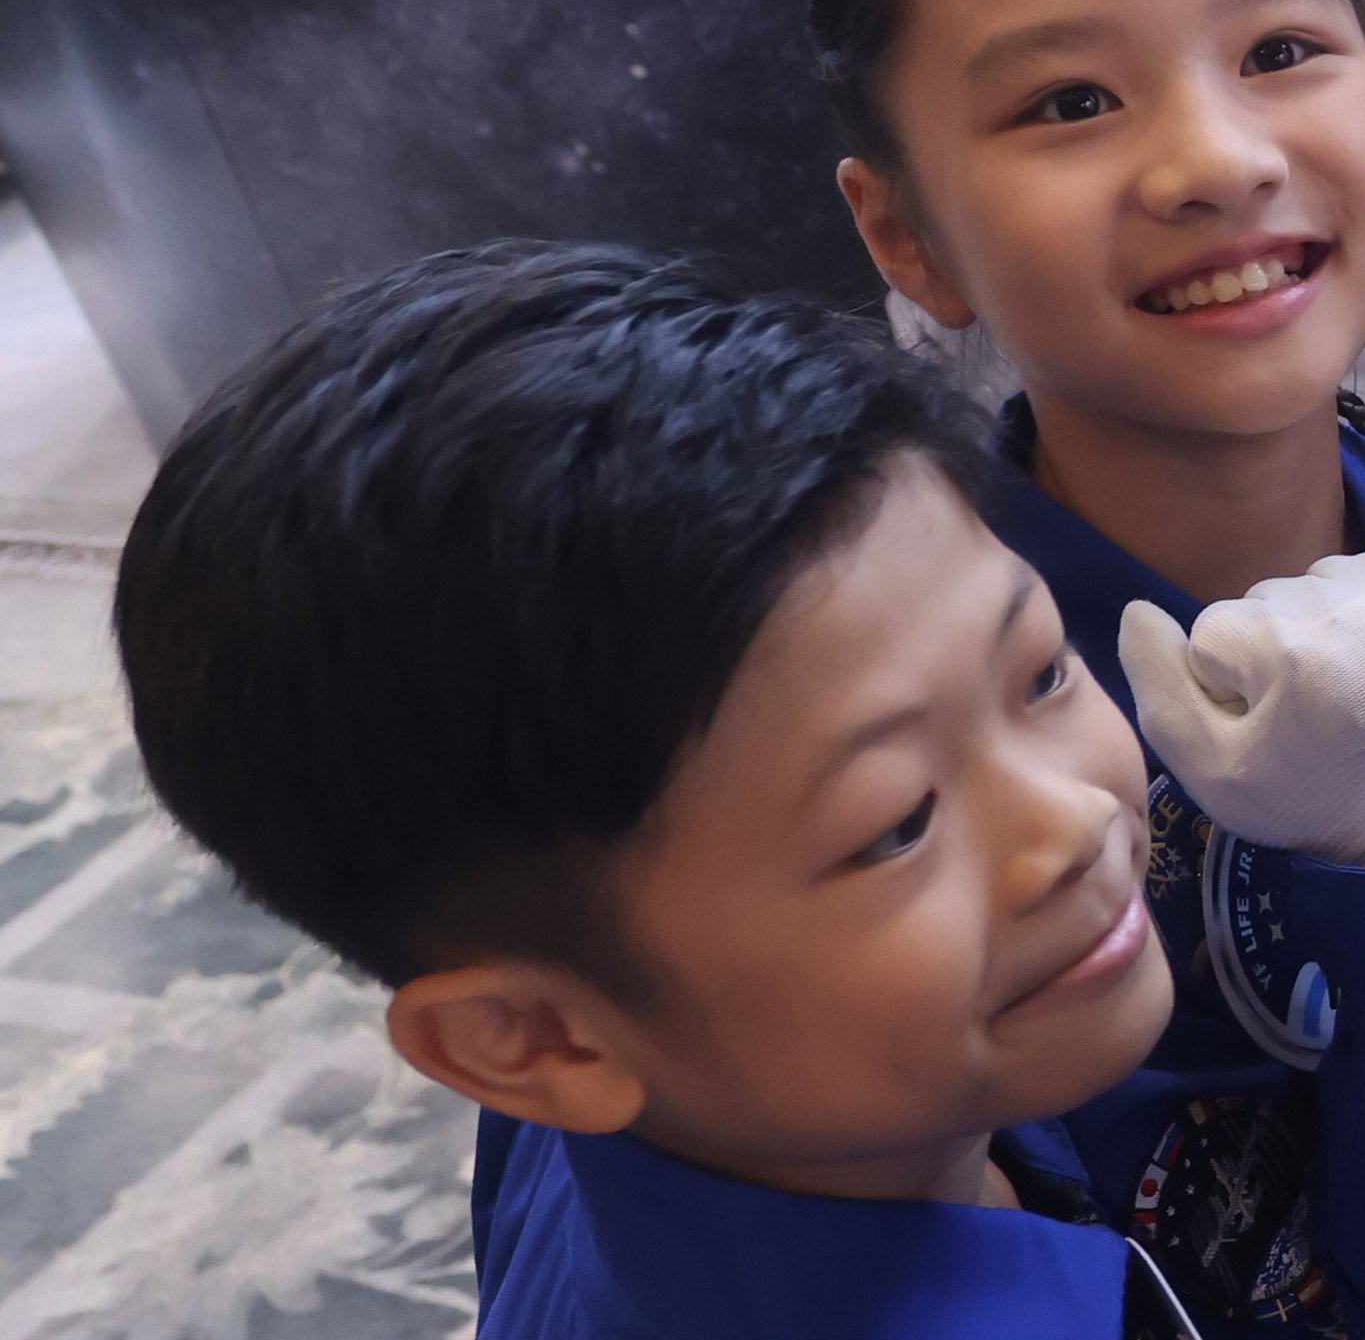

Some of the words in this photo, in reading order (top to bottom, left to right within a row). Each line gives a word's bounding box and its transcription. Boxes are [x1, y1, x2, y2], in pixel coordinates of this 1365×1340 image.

[1237, 848, 1256, 886] JR.
[1237, 897, 1257, 954] LIFE
[1253, 962, 1272, 991] YF
